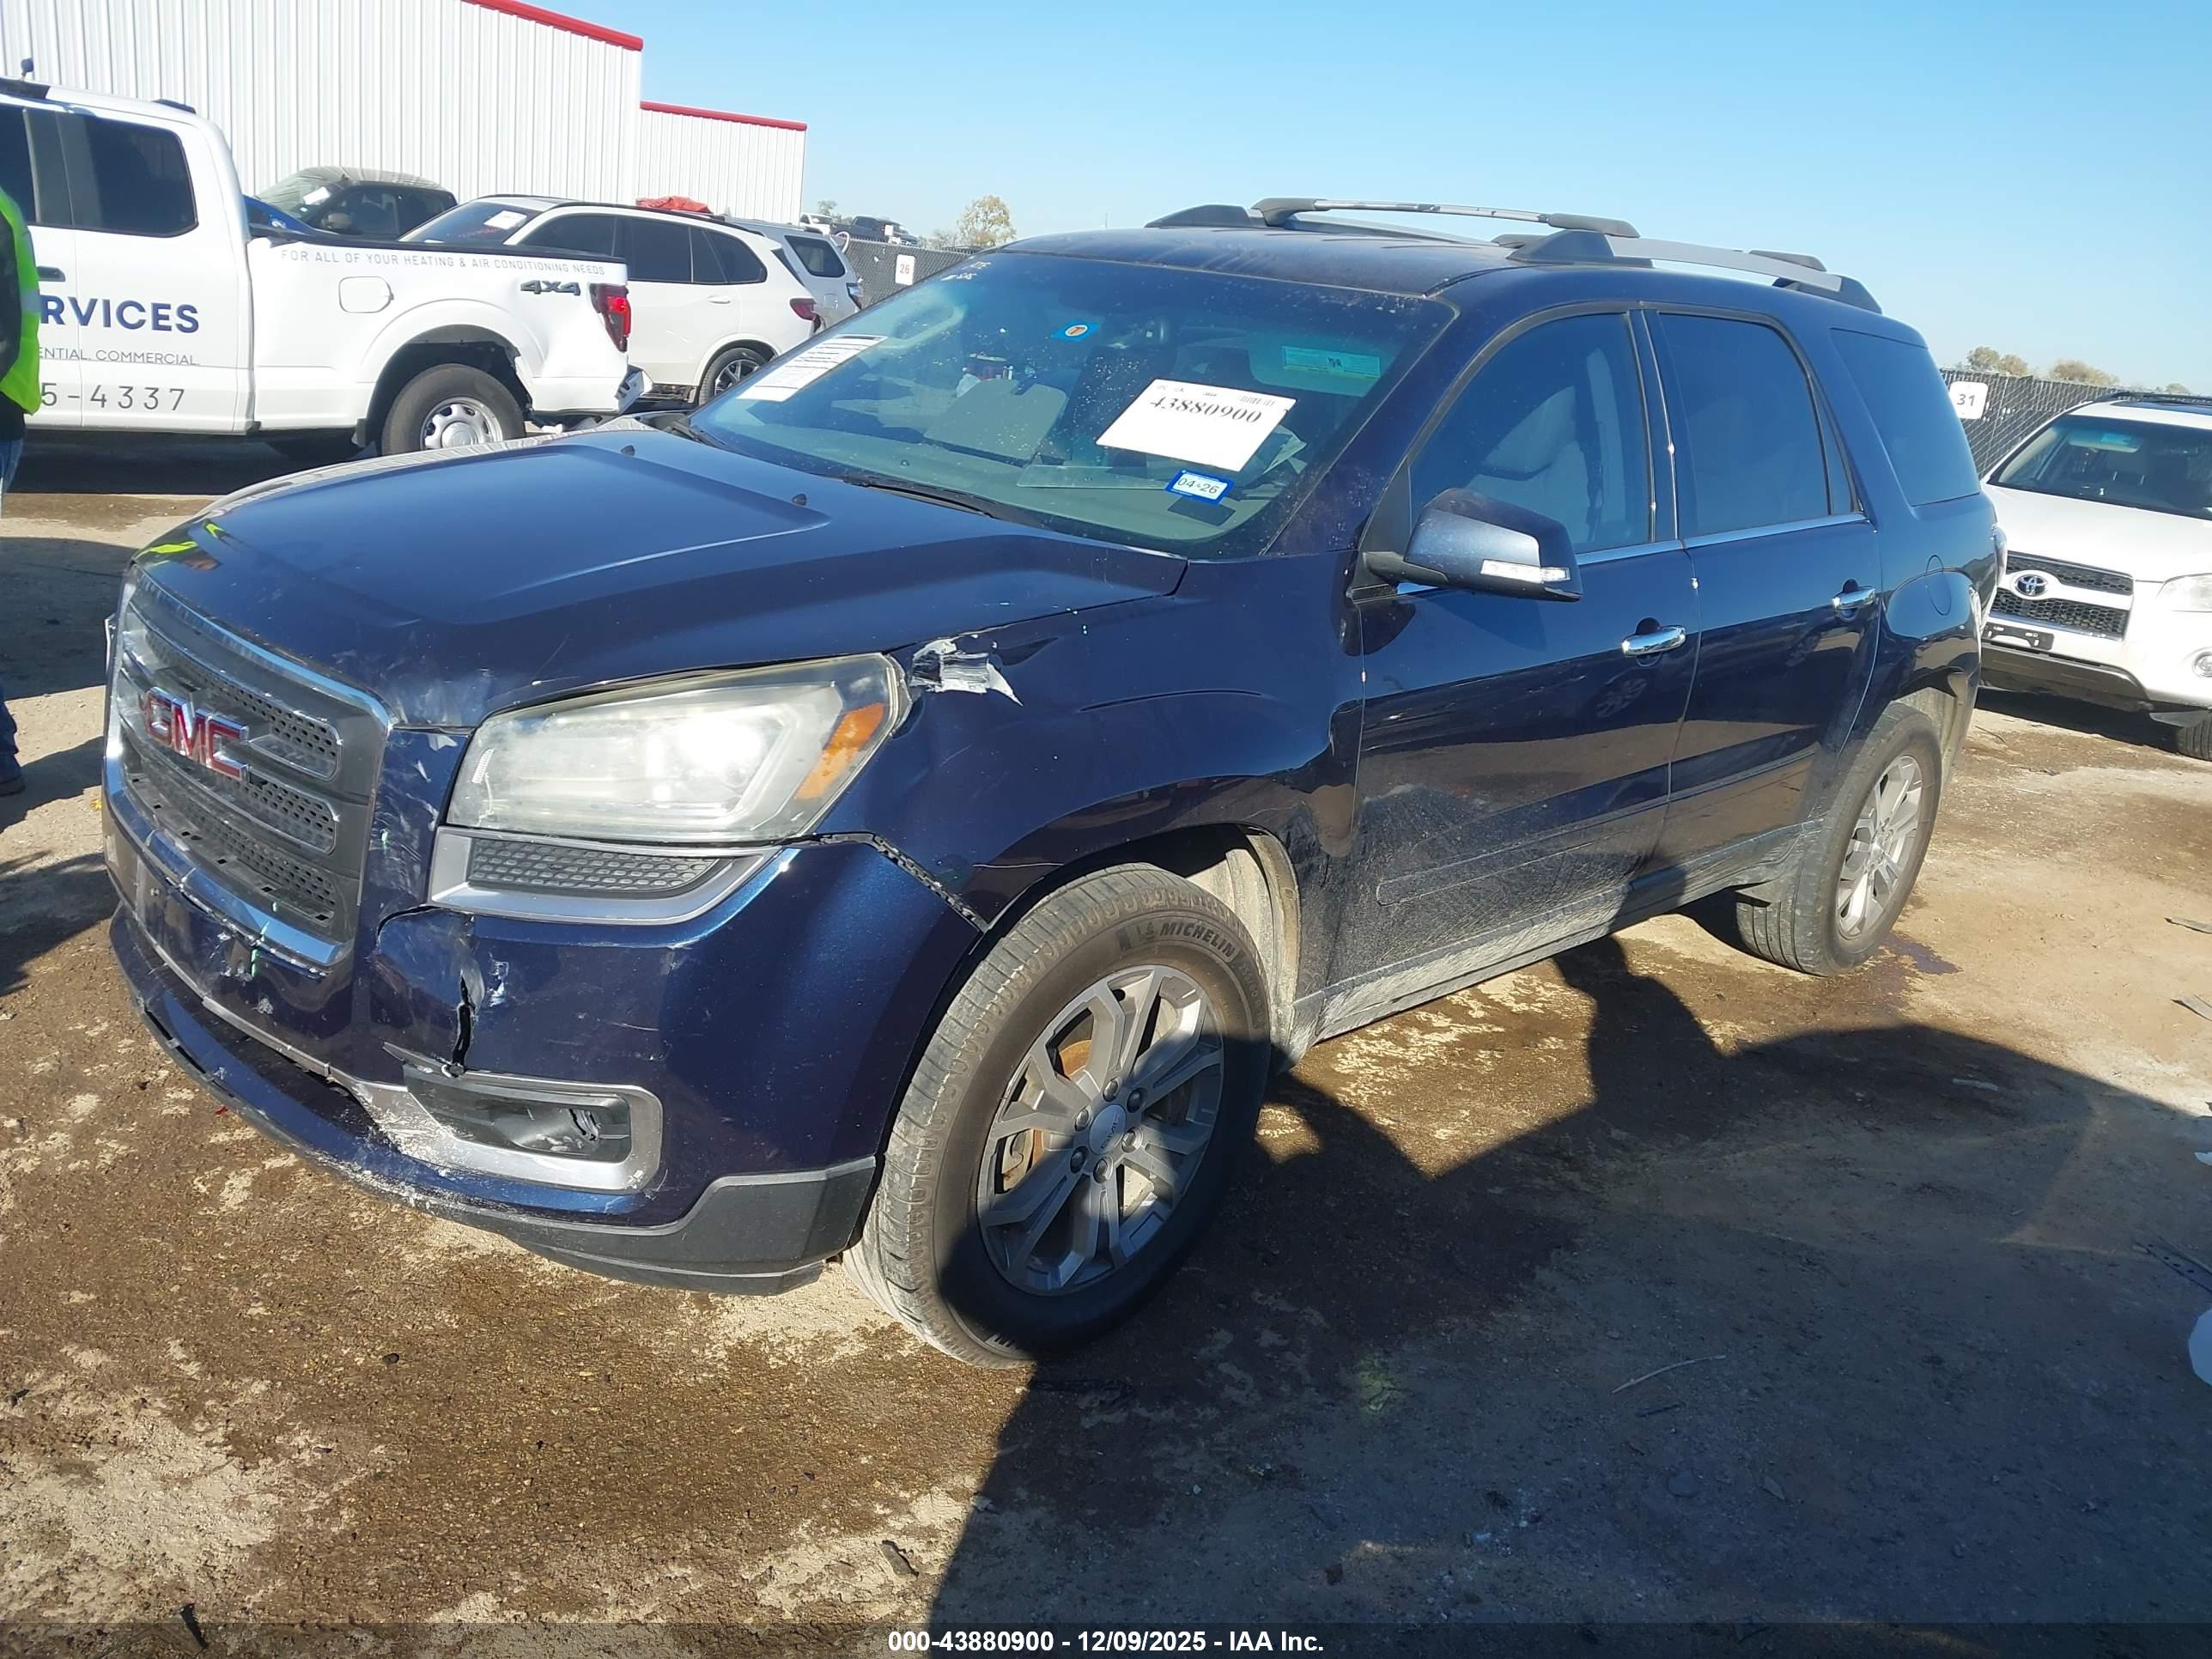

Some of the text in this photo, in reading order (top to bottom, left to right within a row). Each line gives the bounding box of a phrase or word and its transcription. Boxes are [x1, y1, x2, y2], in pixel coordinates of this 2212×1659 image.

[282, 249, 605, 276] FOR ALL OF YOUR HEATING & AIR CONDITIONING NEEDS
[899, 263, 910, 275] 26
[40, 294, 200, 334] RVICES
[95, 349, 201, 367] COMMERCIAL.
[1149, 396, 1263, 423] 43880900
[1956, 392, 1976, 407] 31
[144, 686, 250, 781] GMC
[1159, 921, 1237, 958] MICHELIN
